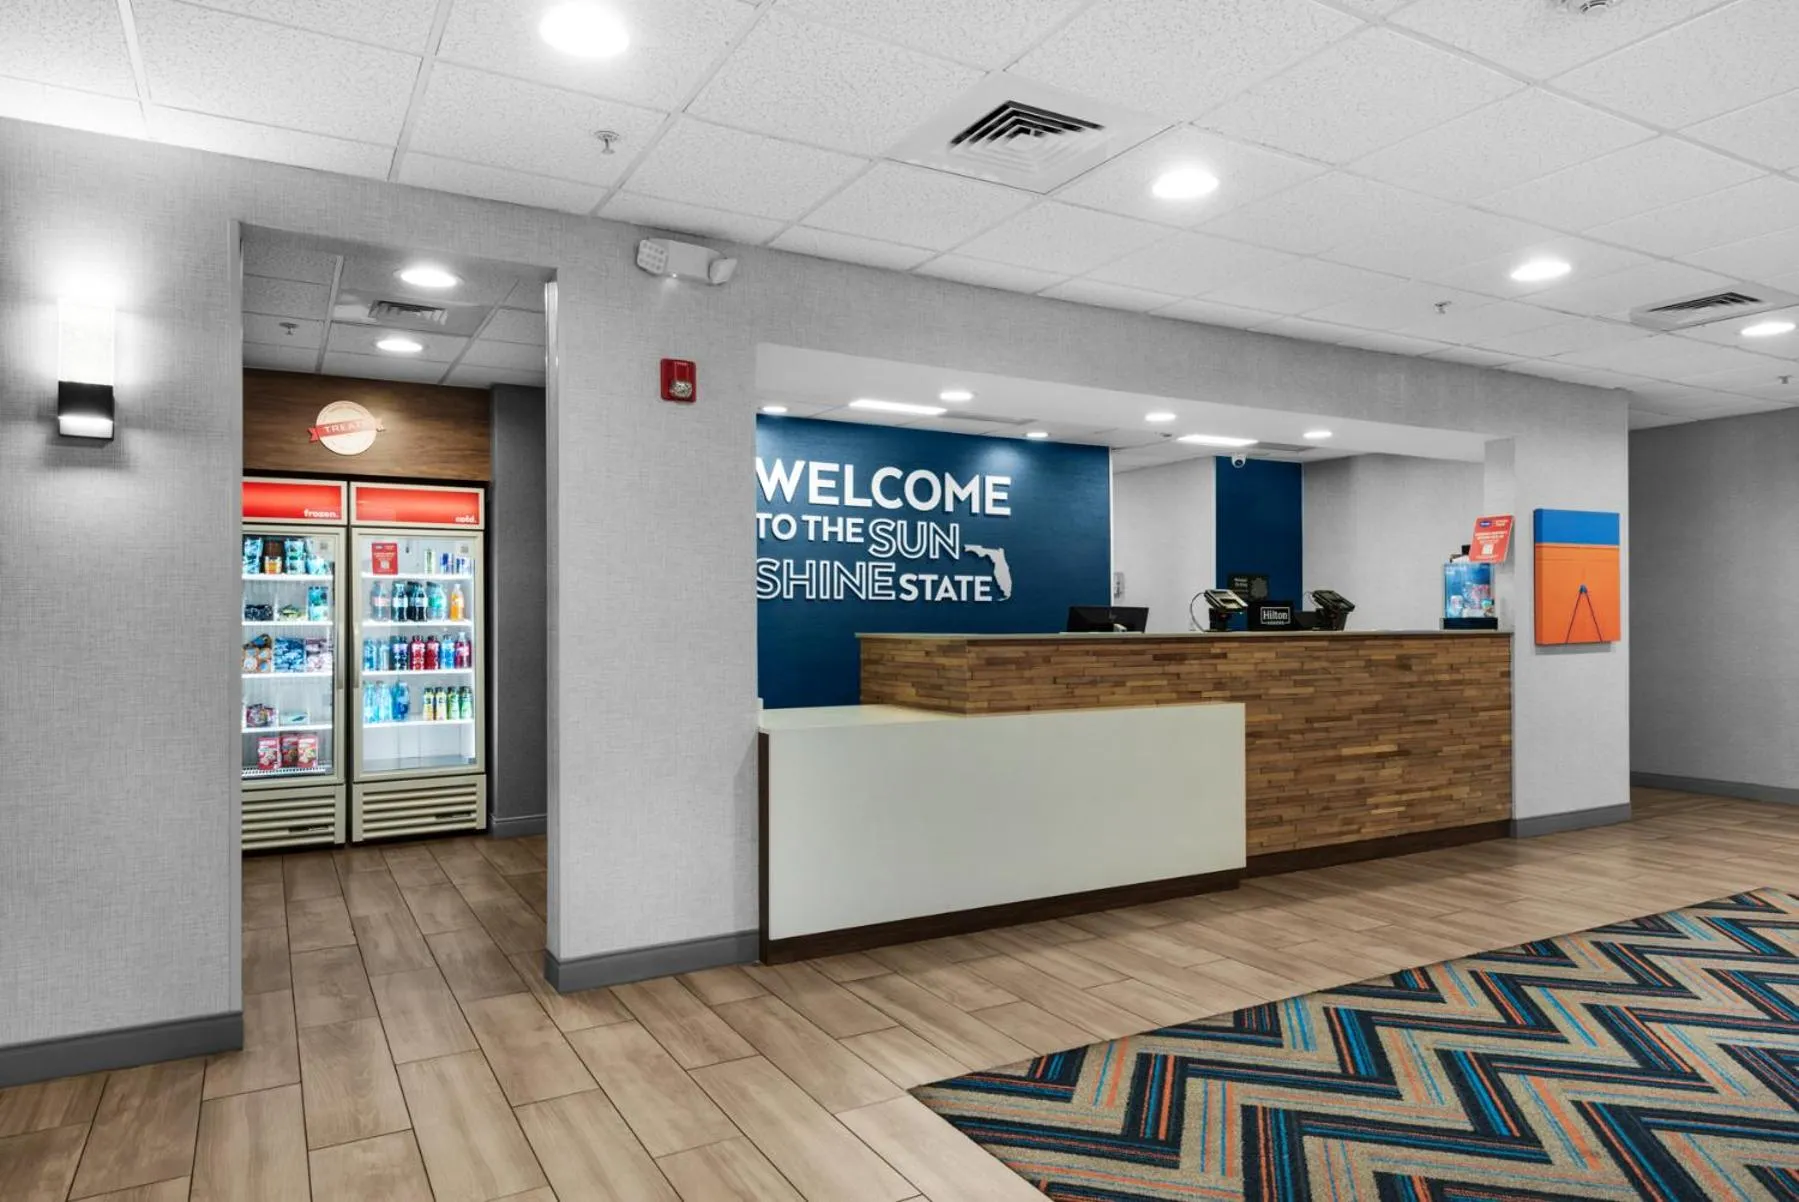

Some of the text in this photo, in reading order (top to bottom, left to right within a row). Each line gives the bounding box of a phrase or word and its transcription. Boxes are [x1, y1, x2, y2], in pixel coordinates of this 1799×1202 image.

[755, 457, 1012, 516] WELCOME
[756, 512, 960, 560] TO THE SUN
[756, 558, 993, 602] SHINE STATE
[1263, 609, 1288, 620] Hilton
